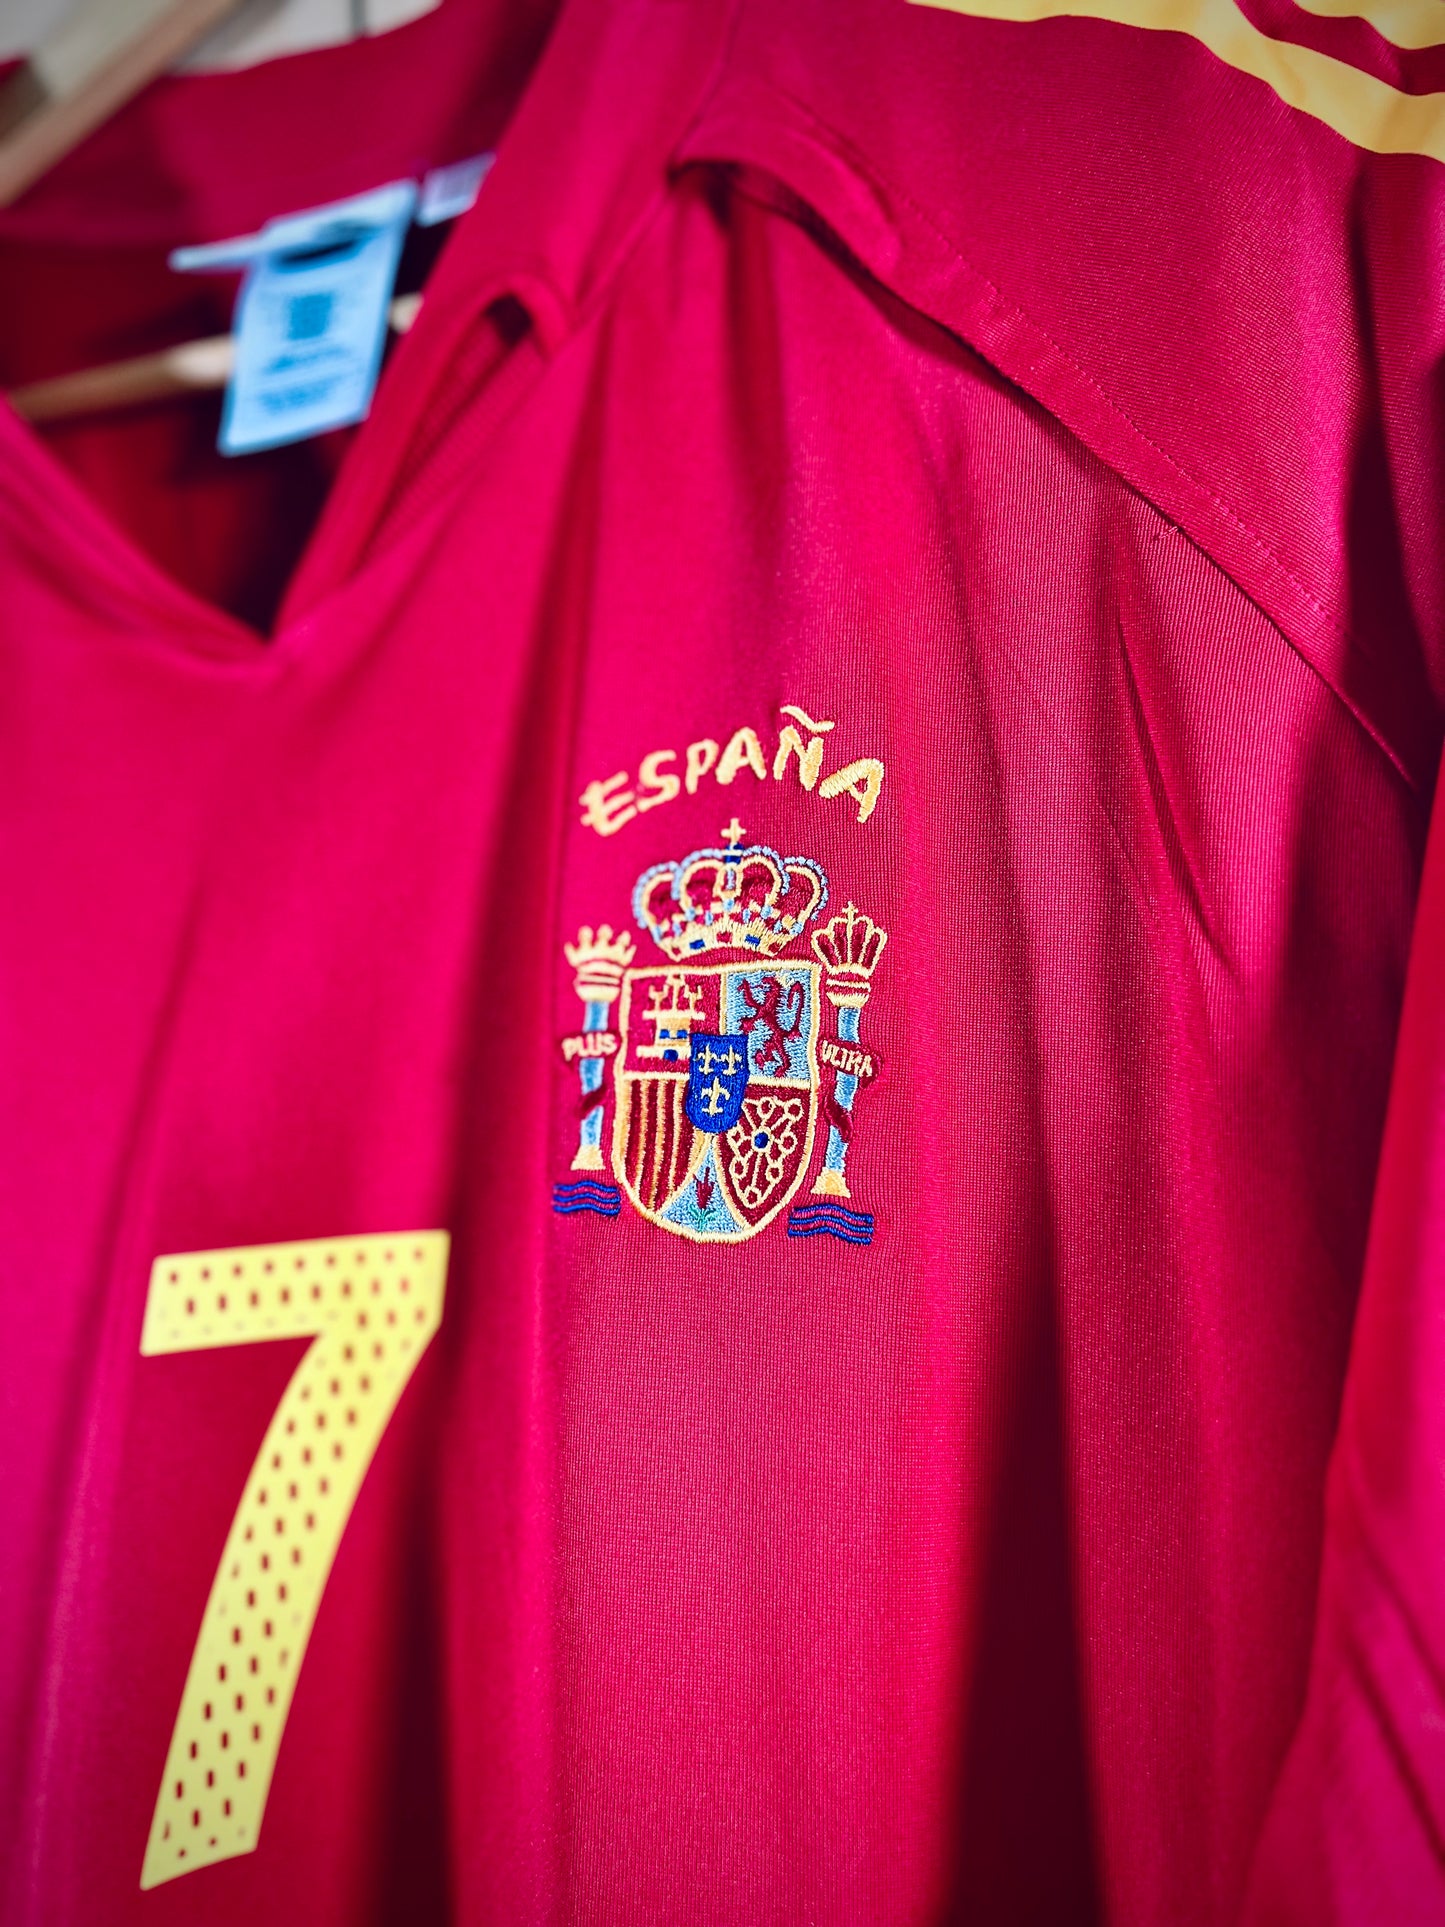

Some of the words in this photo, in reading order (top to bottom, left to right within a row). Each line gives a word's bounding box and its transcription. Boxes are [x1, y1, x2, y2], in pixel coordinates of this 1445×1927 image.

[579, 704, 885, 836] ESPAÑA
[561, 1033, 617, 1061] PLUS
[140, 1230, 450, 1891] 7
